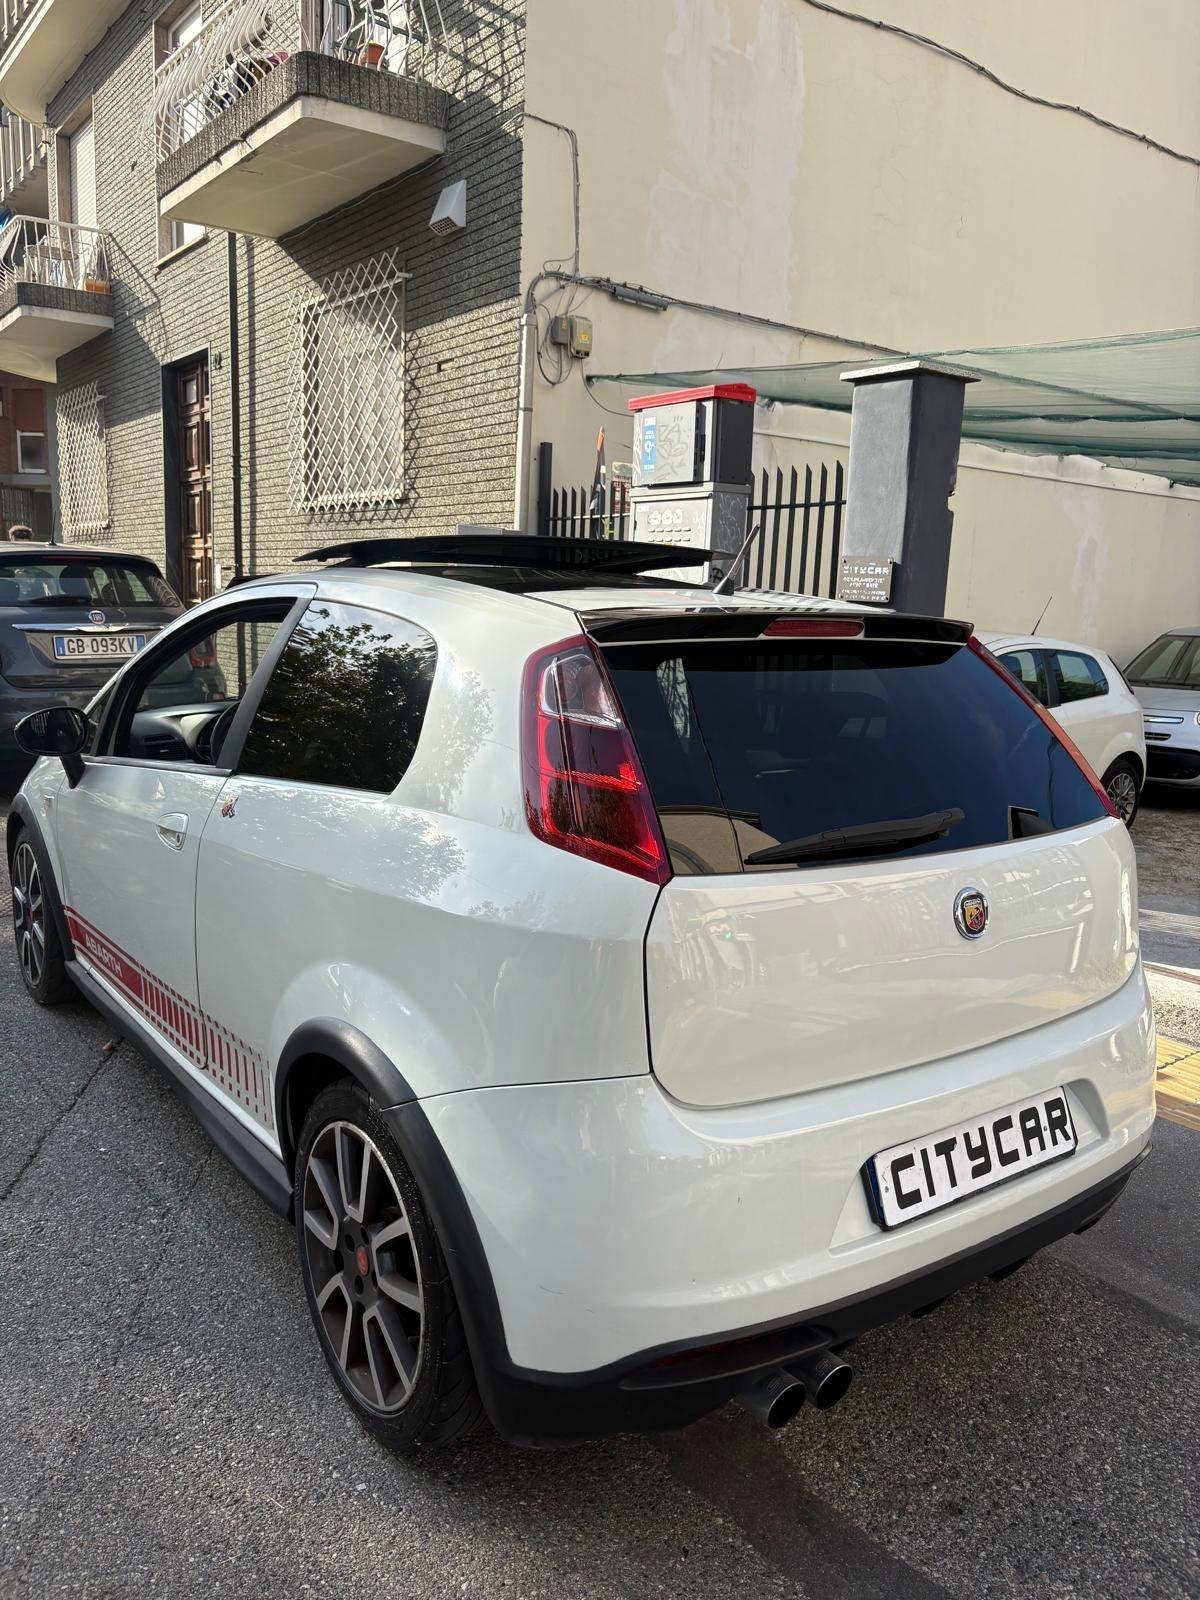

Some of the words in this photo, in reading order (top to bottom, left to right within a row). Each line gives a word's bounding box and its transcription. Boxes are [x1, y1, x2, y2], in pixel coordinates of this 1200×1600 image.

[66, 638, 86, 654] GB
[90, 637, 135, 653] 093KV
[85, 934, 123, 977] ABARTH
[890, 1096, 1071, 1210] CITYCAR
